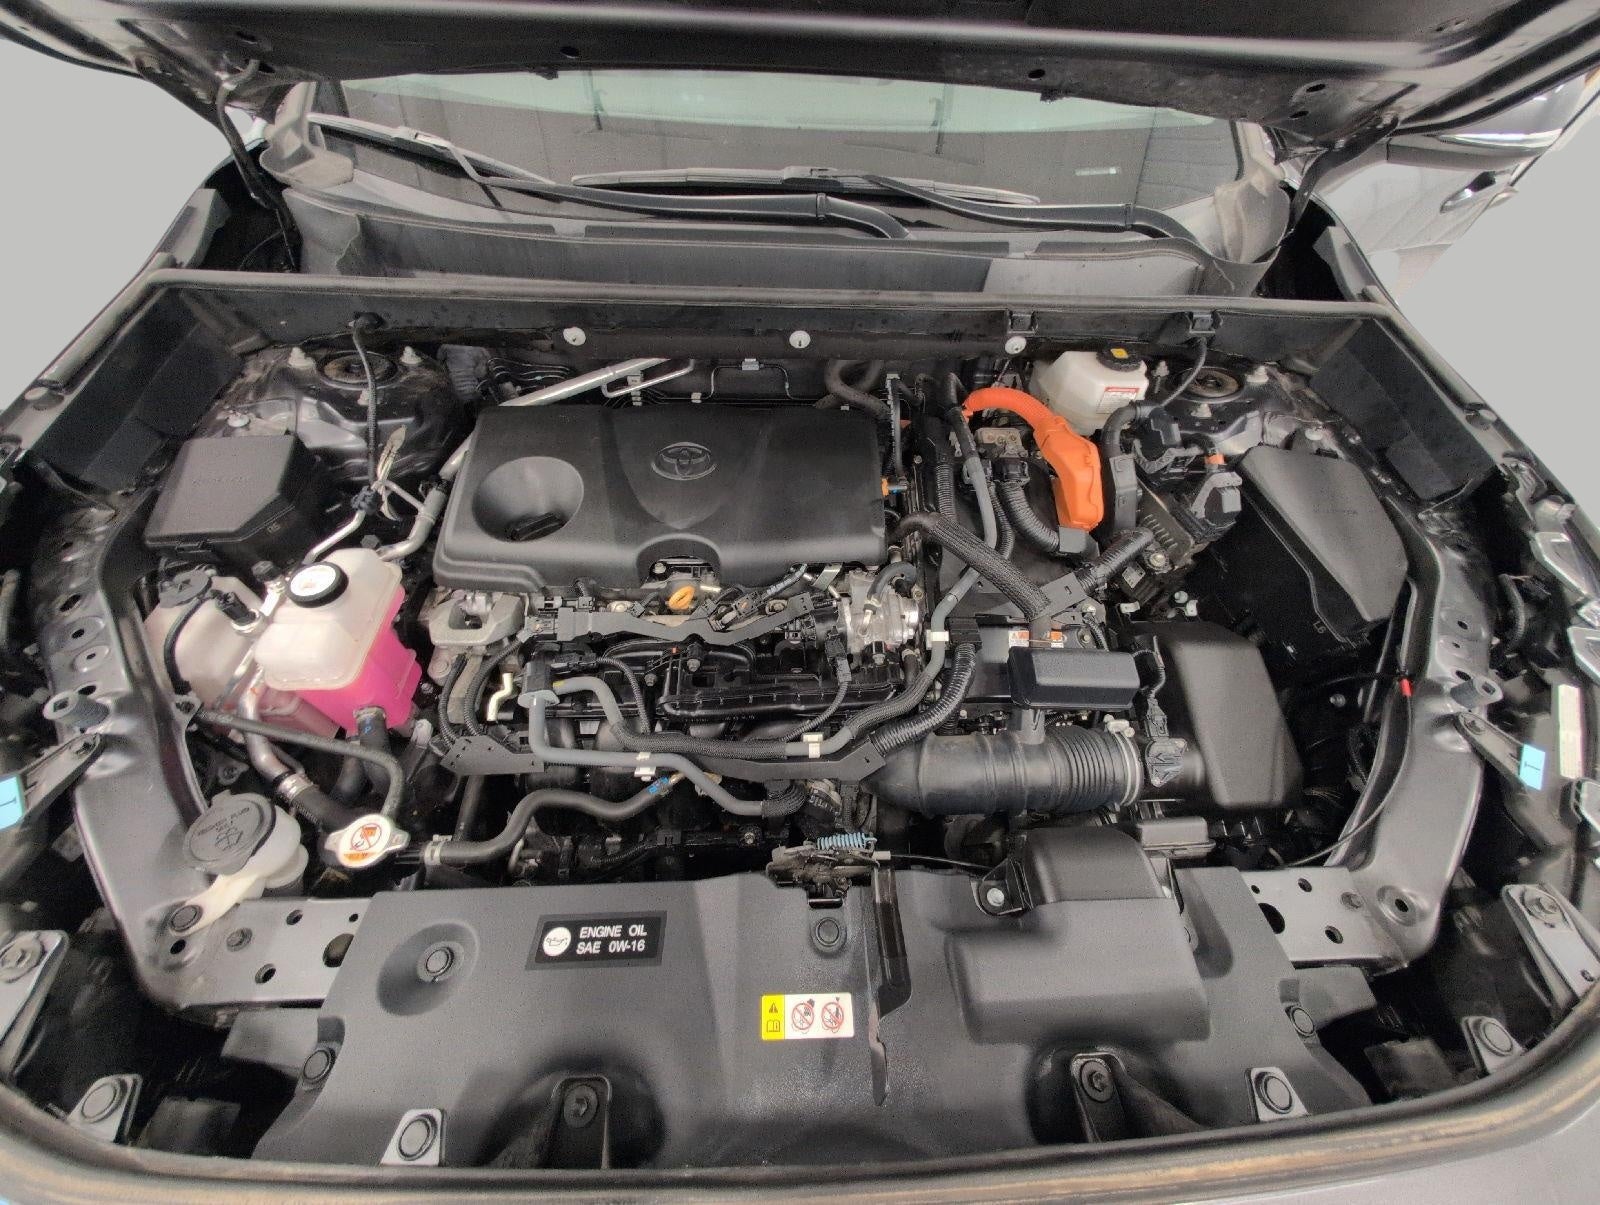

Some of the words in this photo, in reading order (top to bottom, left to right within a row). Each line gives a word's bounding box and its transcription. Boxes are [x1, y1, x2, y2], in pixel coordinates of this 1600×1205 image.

[579, 925, 623, 939] ENGINE
[628, 924, 648, 936] OIL
[576, 941, 601, 955] SAE
[608, 939, 646, 953] 0W-16
